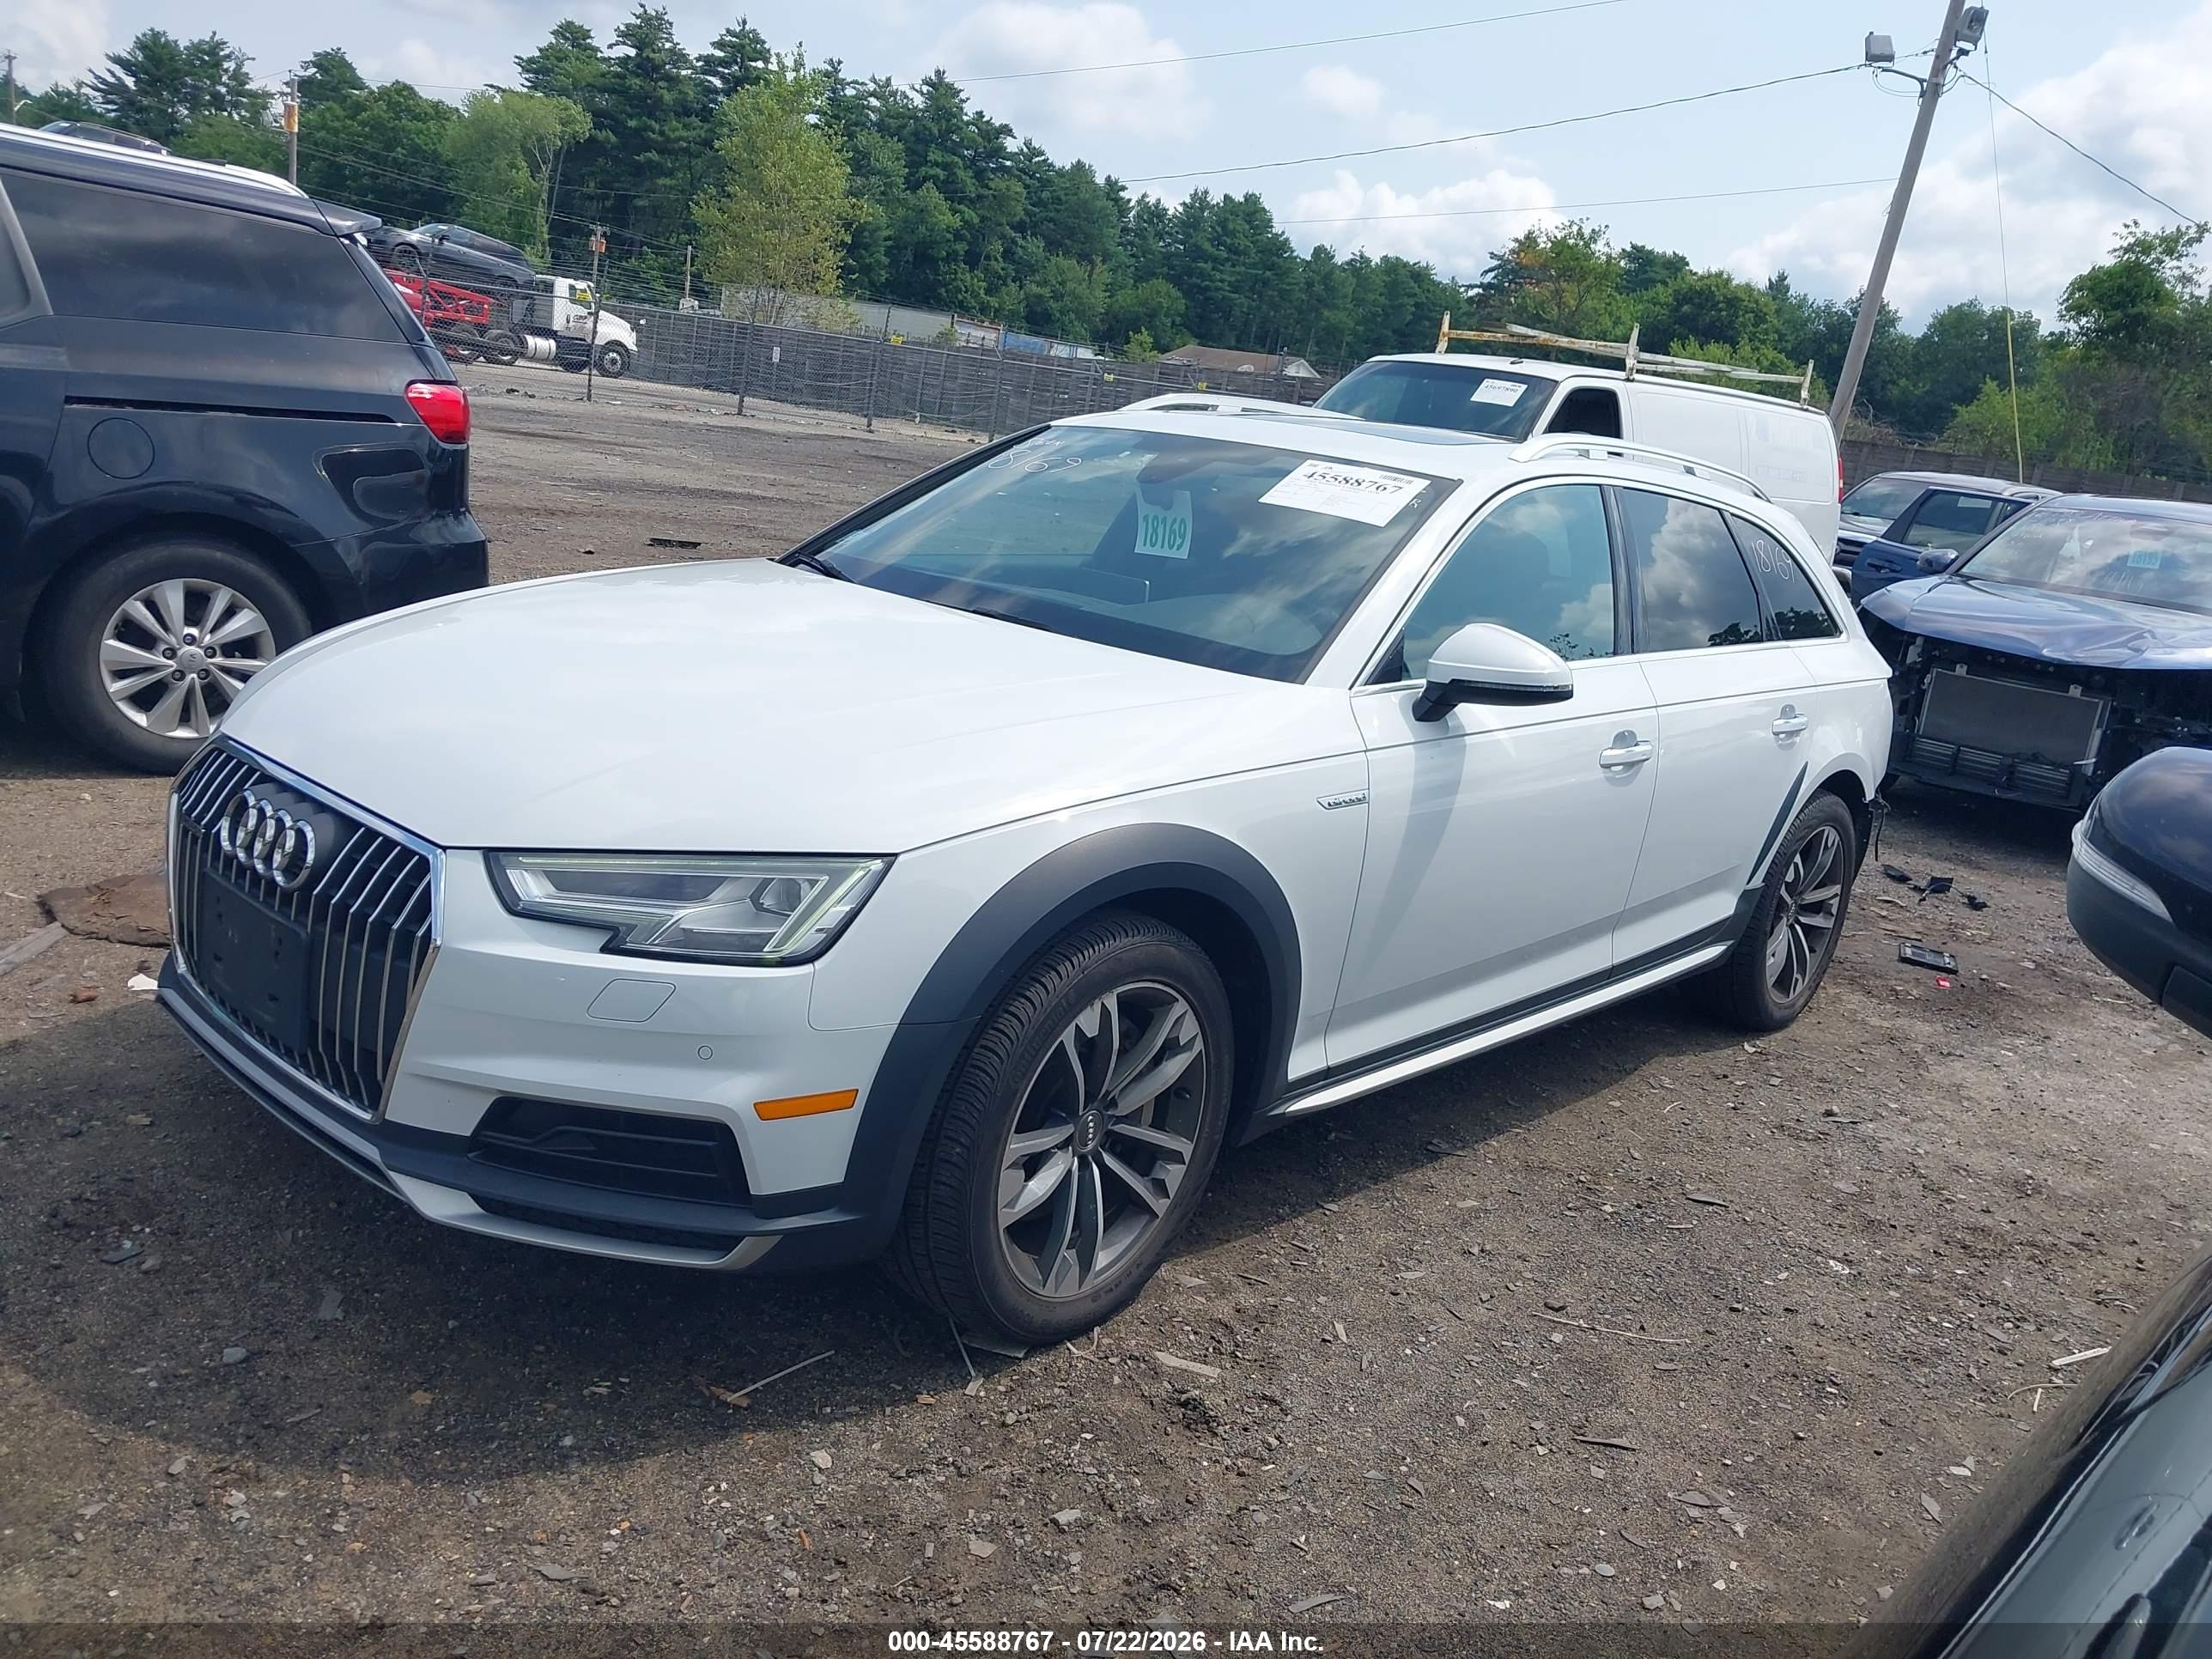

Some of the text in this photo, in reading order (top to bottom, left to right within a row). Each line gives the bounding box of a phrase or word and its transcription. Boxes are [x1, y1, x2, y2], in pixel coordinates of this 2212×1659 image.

[1302, 471, 1405, 495] 45588767
[1143, 514, 1188, 551] 18169
[1752, 539, 1795, 584] 18169
